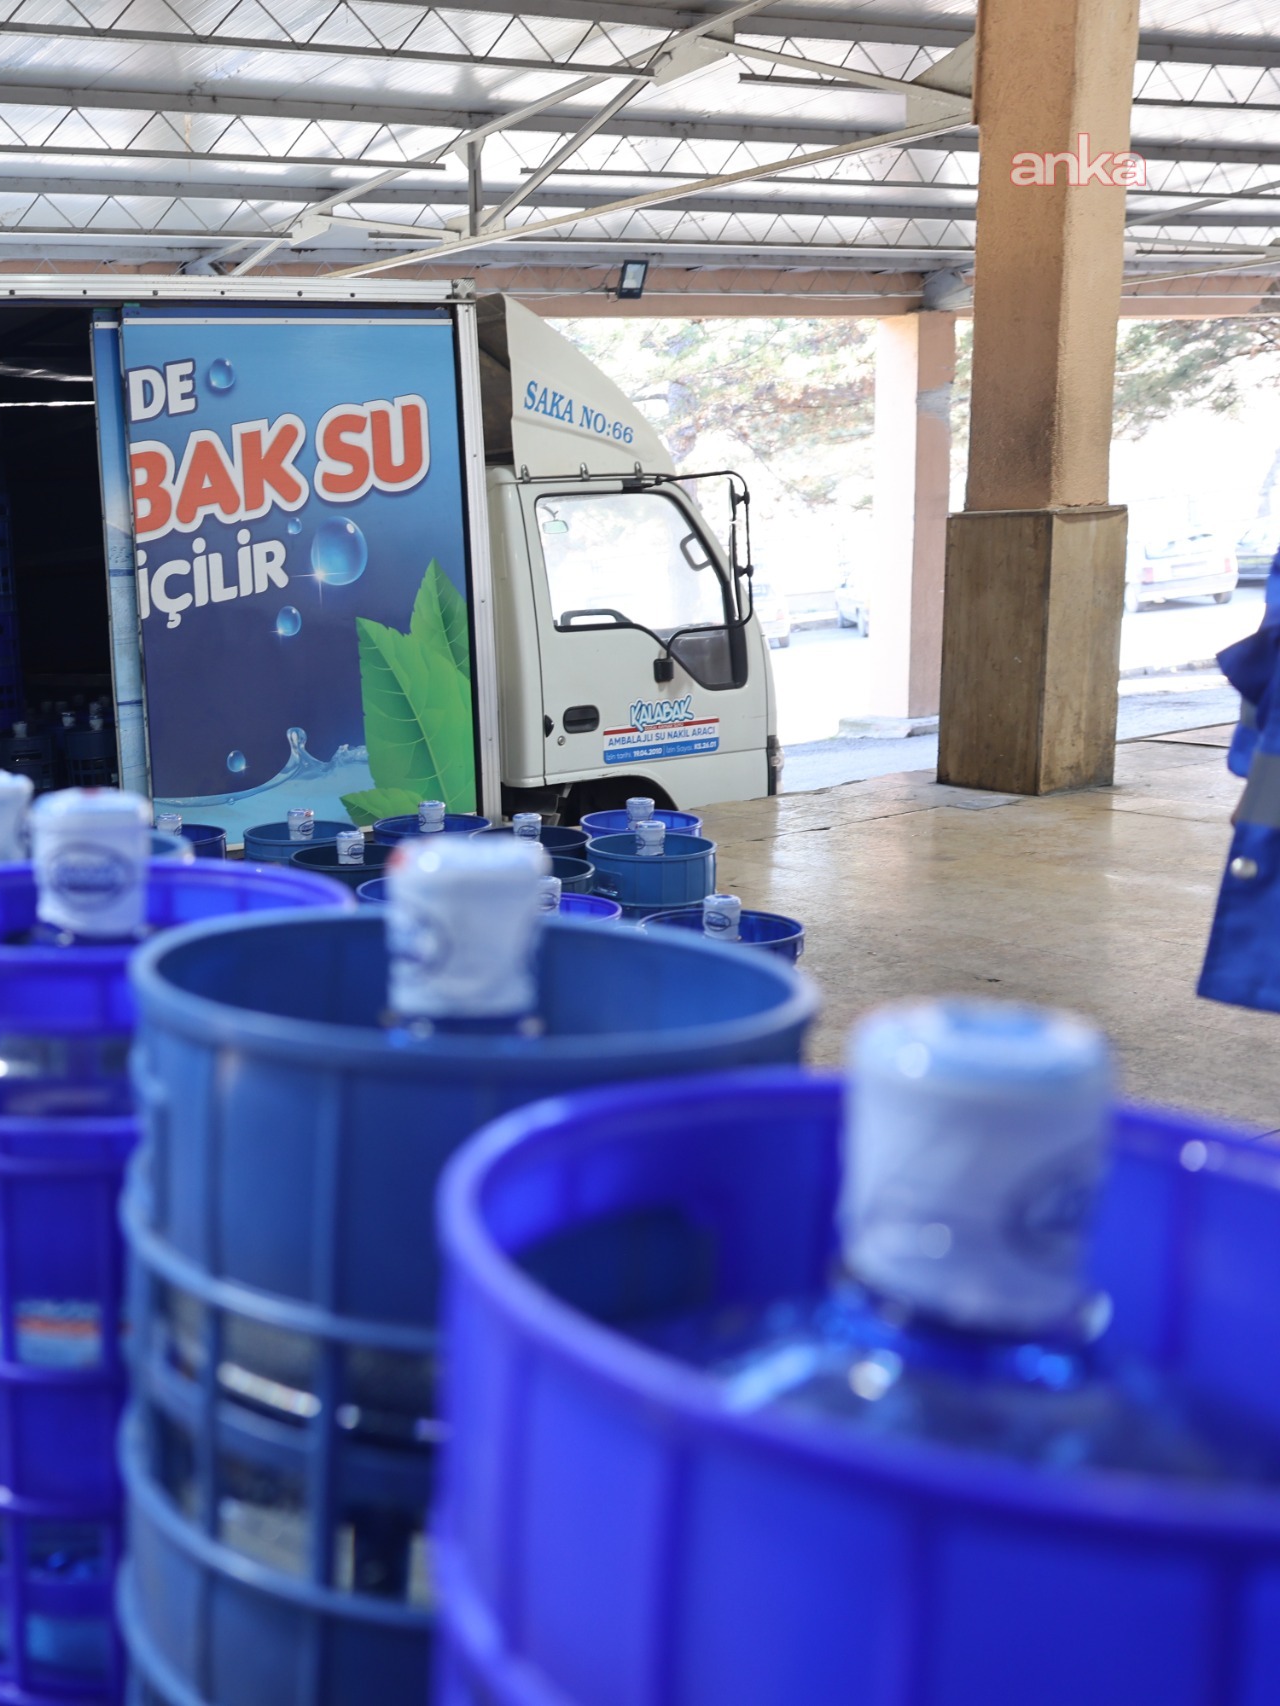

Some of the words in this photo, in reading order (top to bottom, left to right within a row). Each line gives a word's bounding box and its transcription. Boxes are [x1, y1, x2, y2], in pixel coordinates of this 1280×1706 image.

[127, 361, 195, 422] DE
[523, 380, 574, 424] SAKA
[579, 405, 634, 444] NO:66
[314, 393, 430, 502] SU
[608, 733, 653, 746] AMBALAJLI
[655, 731, 666, 741] SU
[667, 728, 690, 739] NAKİL
[692, 726, 716, 737] ARACI
[630, 694, 694, 733] KALABAK
